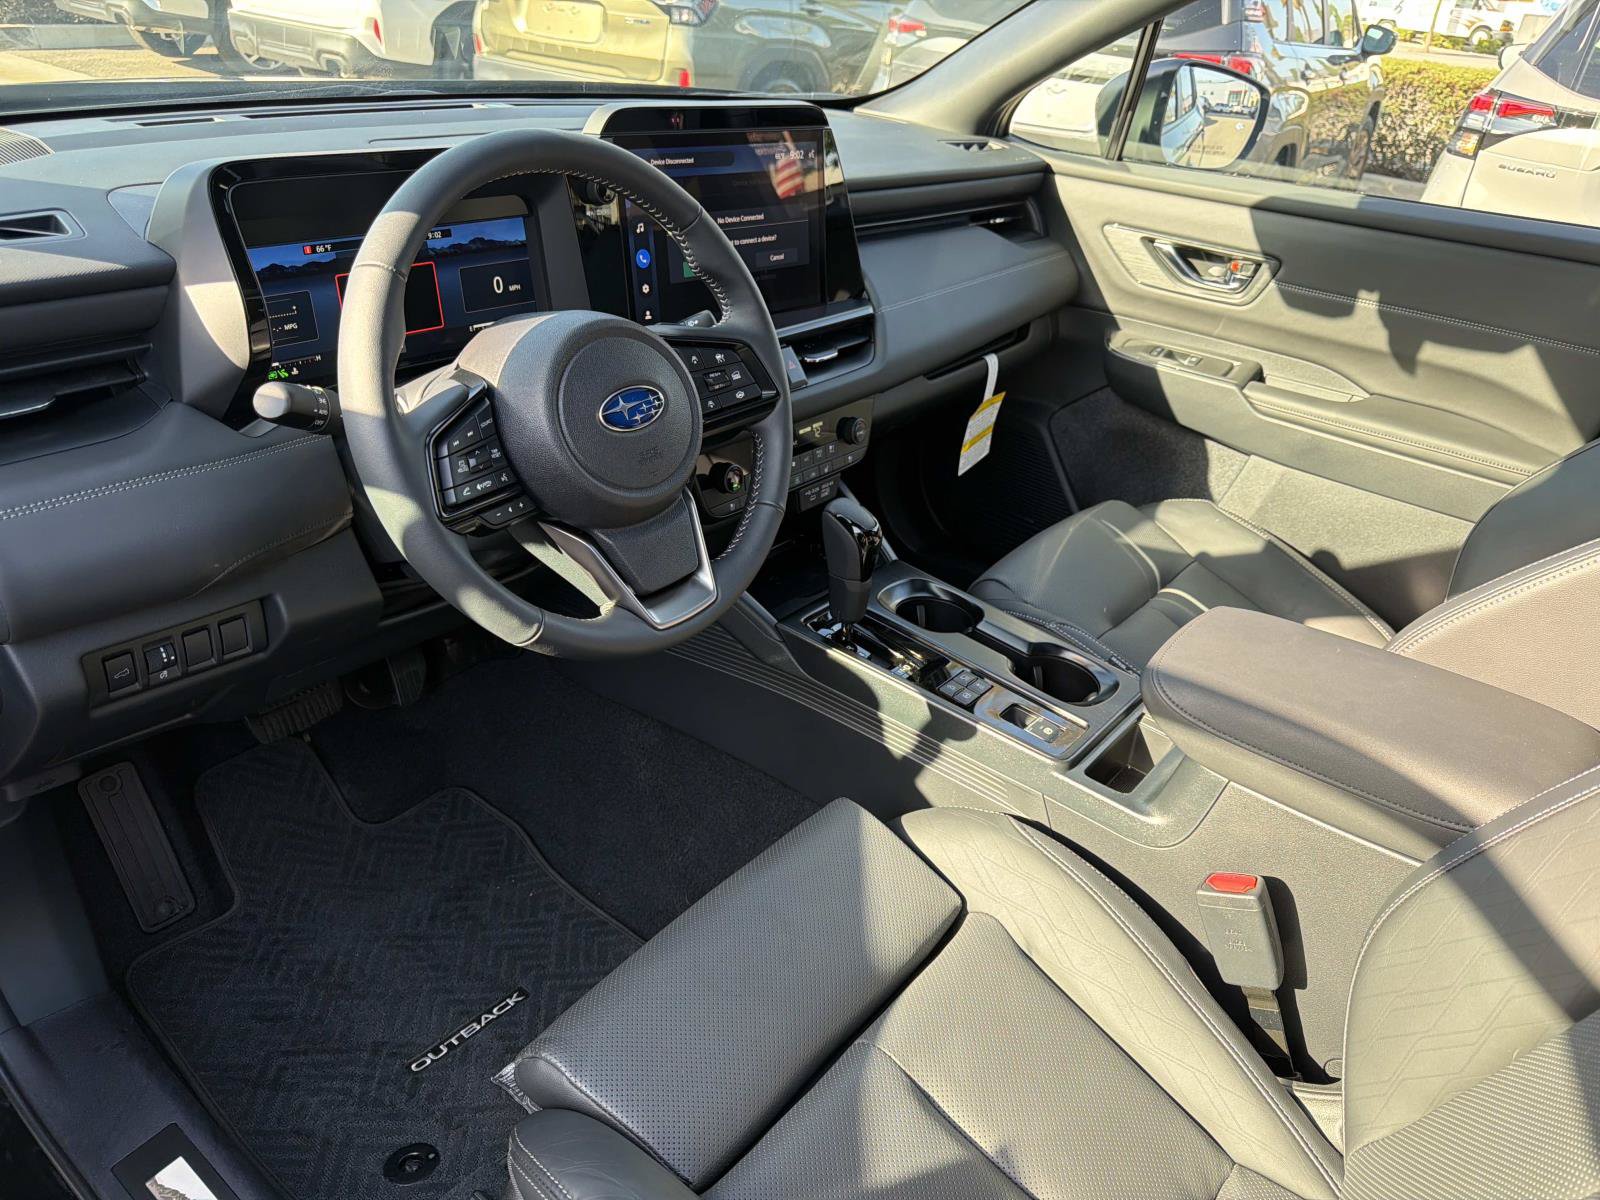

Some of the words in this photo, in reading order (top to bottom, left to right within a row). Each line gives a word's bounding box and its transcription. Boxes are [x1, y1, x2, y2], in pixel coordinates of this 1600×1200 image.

[665, 157, 694, 165] Disconnected
[1498, 163, 1557, 179] SUBARU
[740, 212, 764, 221] Connected
[427, 231, 442, 240] 9:02
[762, 234, 777, 242] device?
[769, 253, 785, 261] Cancel
[493, 276, 504, 294] 0
[508, 284, 521, 292] MPH
[283, 323, 298, 331] MPG
[411, 991, 526, 1072] OUTBACK
